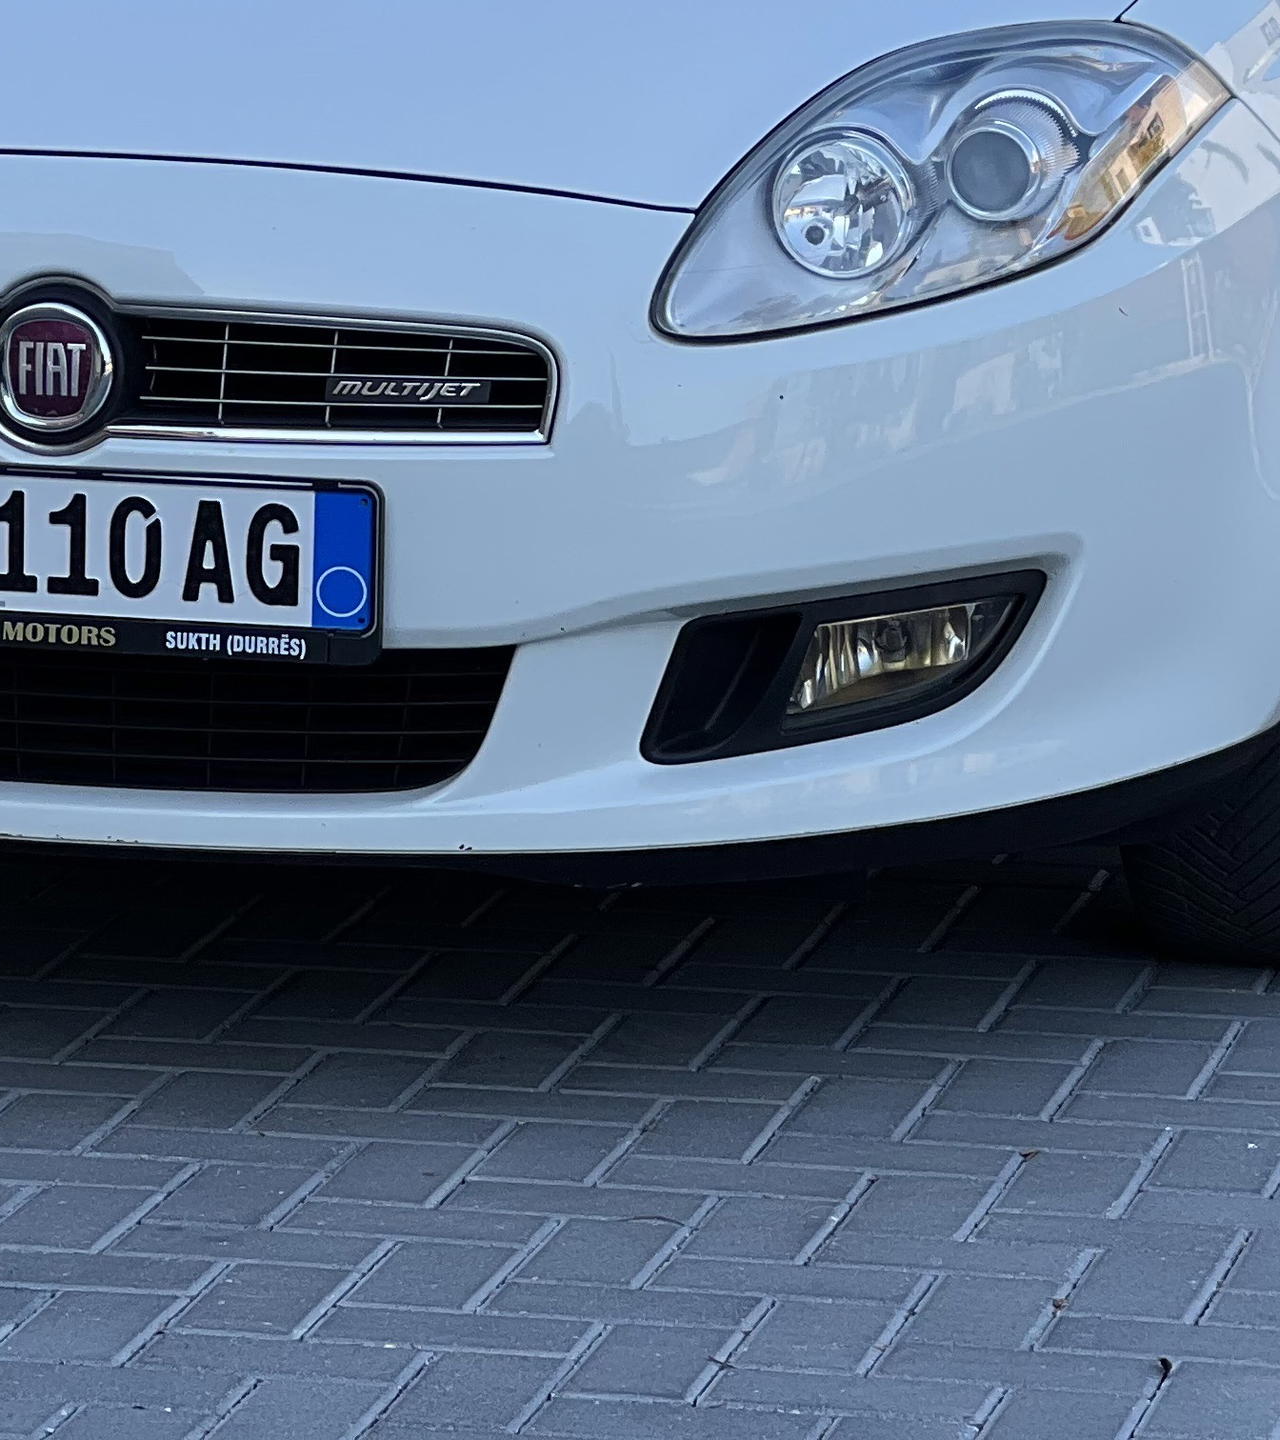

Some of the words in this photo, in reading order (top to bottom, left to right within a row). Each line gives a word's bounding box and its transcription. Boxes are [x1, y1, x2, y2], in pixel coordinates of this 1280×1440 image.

[18, 341, 87, 397] FIAT
[331, 380, 481, 401] MULTIJET
[2, 620, 116, 647] MOTORS
[165, 630, 221, 651] SUKTH
